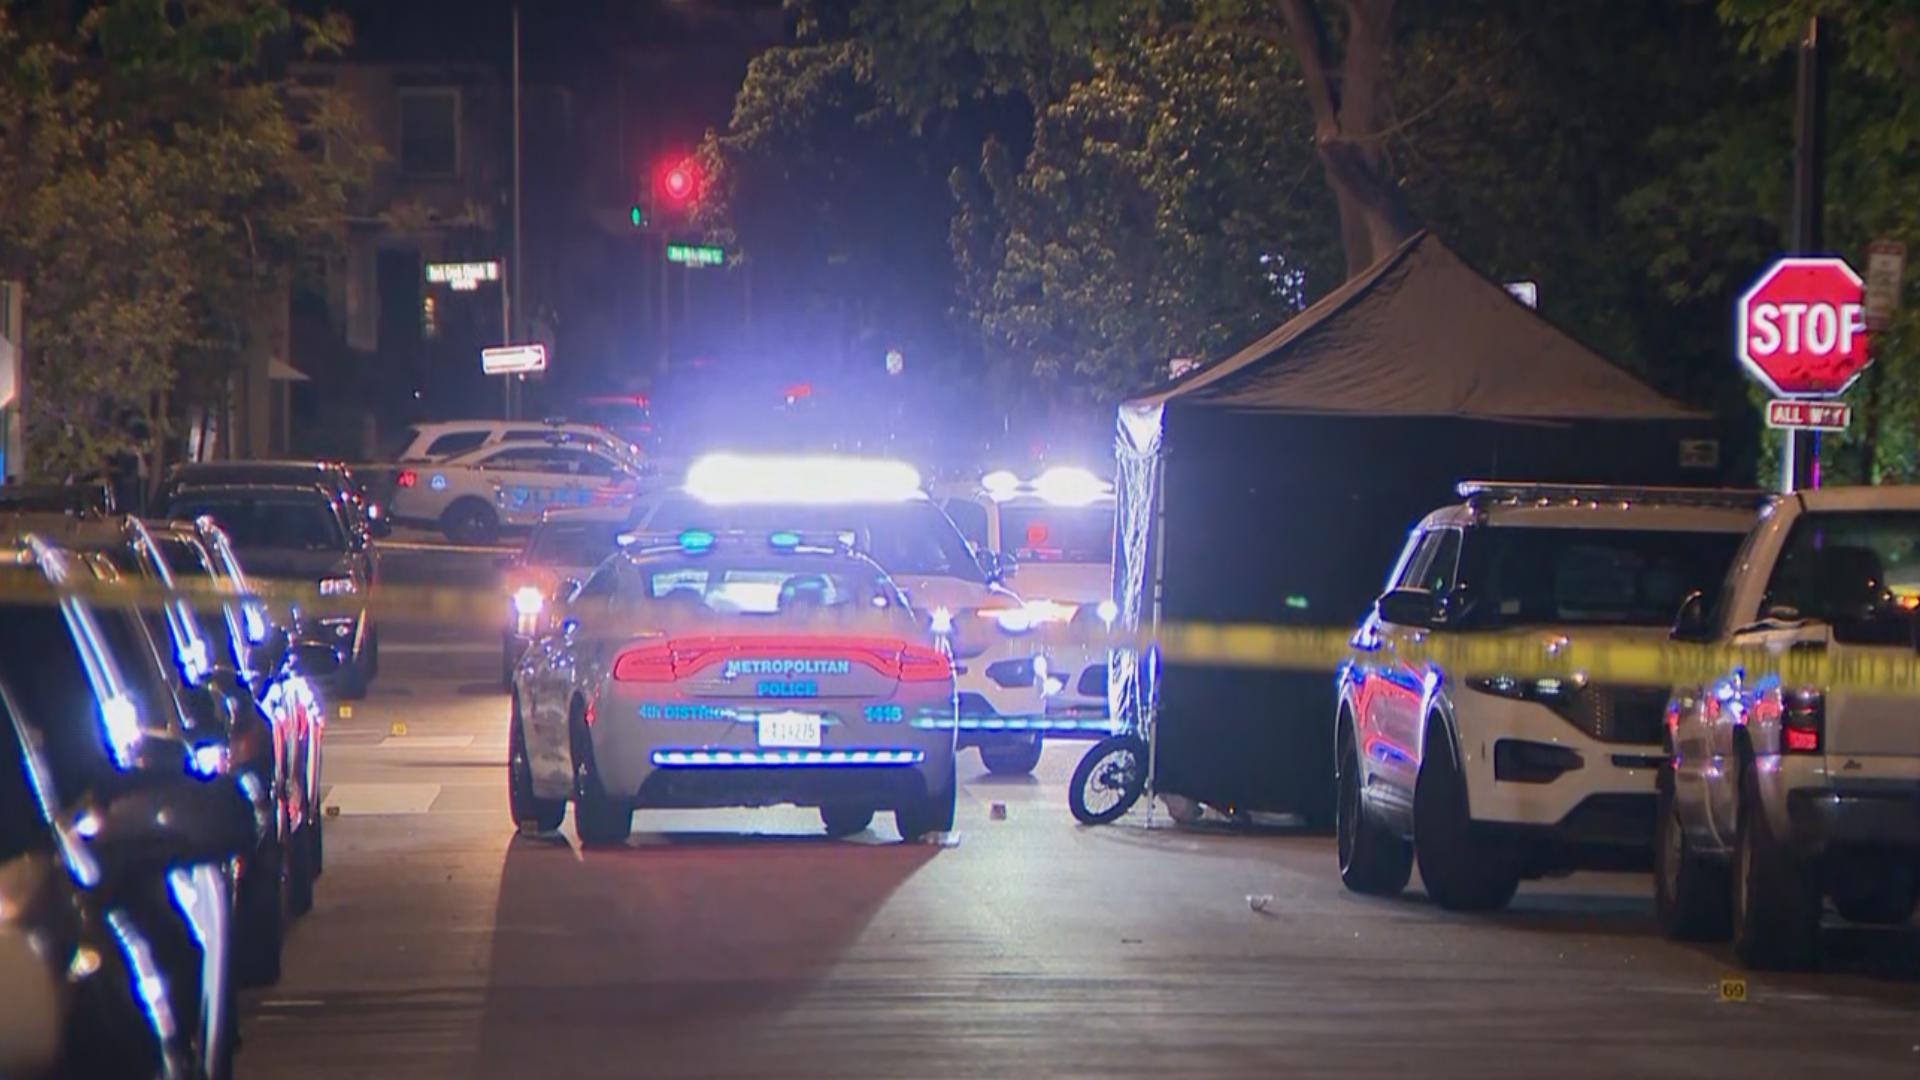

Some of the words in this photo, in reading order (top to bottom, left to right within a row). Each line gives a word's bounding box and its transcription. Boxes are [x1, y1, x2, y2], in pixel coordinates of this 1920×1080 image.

[1752, 303, 1866, 355] STOP
[1774, 406, 1803, 422] ALL
[728, 660, 849, 673] METROPOLITAN
[758, 681, 817, 696] POLICE
[1723, 983, 1745, 998] 69
